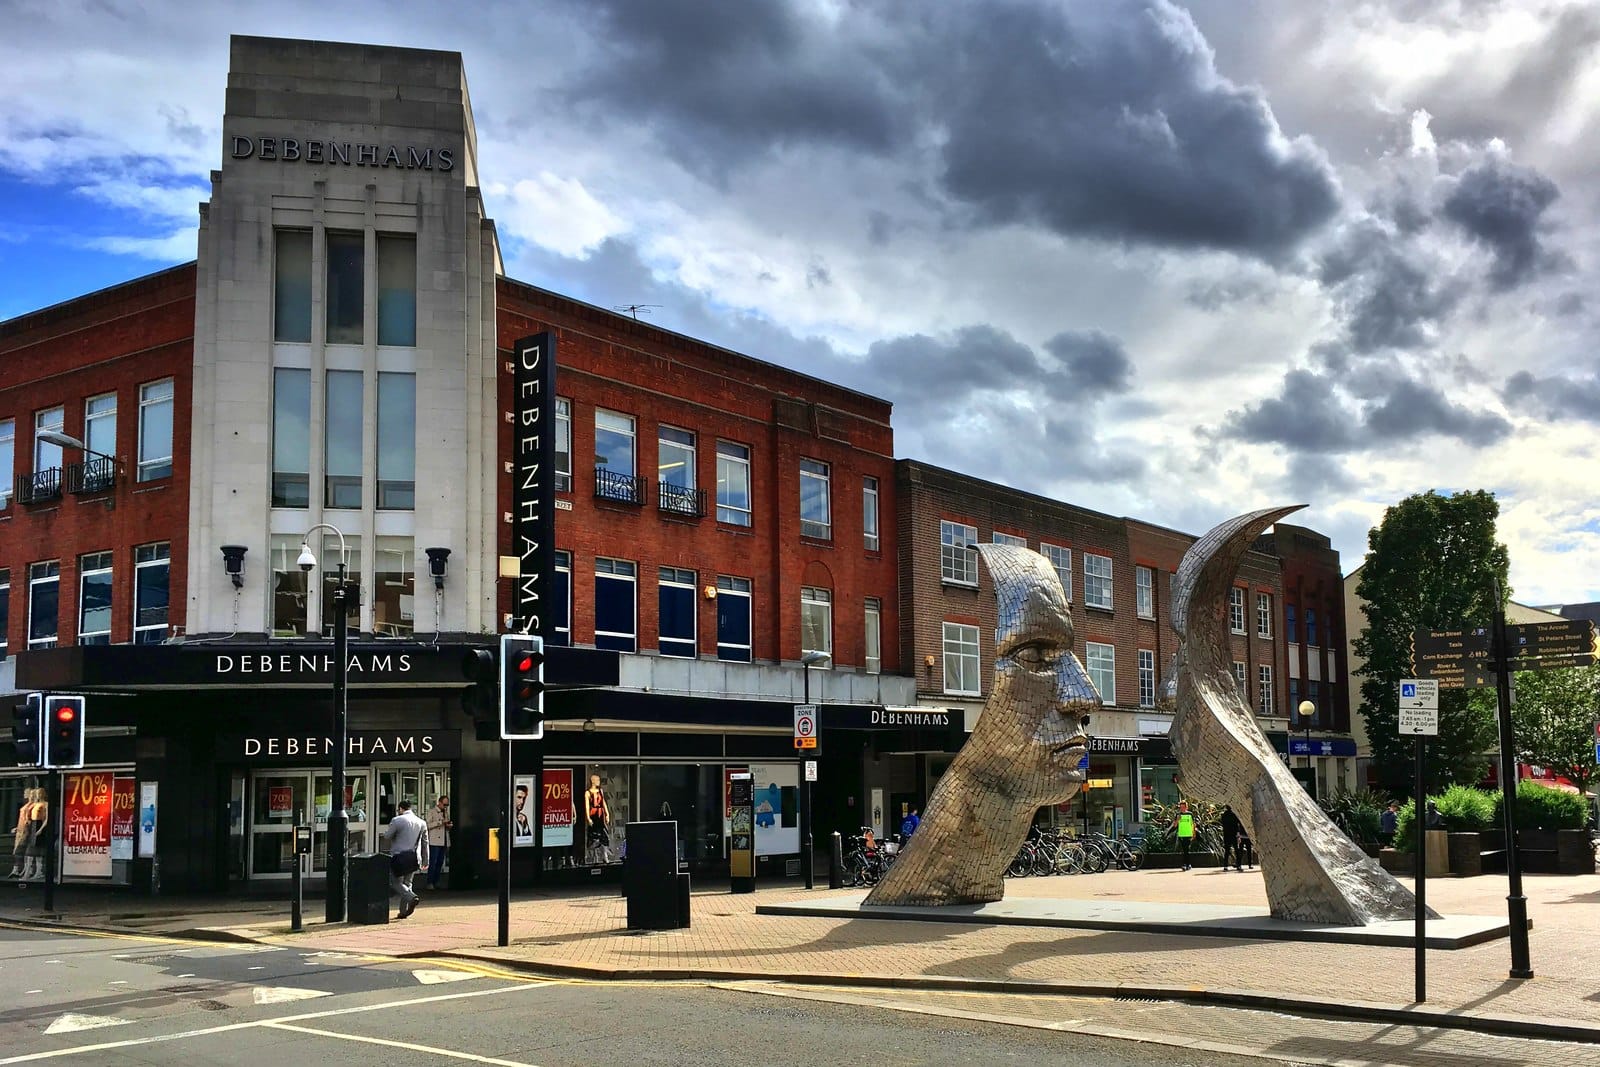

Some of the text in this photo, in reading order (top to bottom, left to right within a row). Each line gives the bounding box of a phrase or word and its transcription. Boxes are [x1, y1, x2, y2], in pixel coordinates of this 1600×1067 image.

[231, 135, 455, 172] DEBENHAMS
[520, 345, 540, 635] DEBENHAMS
[216, 654, 411, 673] DEBENHAMS
[871, 710, 949, 726] DEBENHAMS
[245, 736, 433, 756] DEBENHAMS
[69, 775, 108, 805] 70%
[543, 783, 570, 800] 70%
[94, 795, 108, 805] OFF
[544, 812, 570, 823] FINAL
[68, 823, 106, 842] FINAL
[113, 823, 134, 835] FINAL
